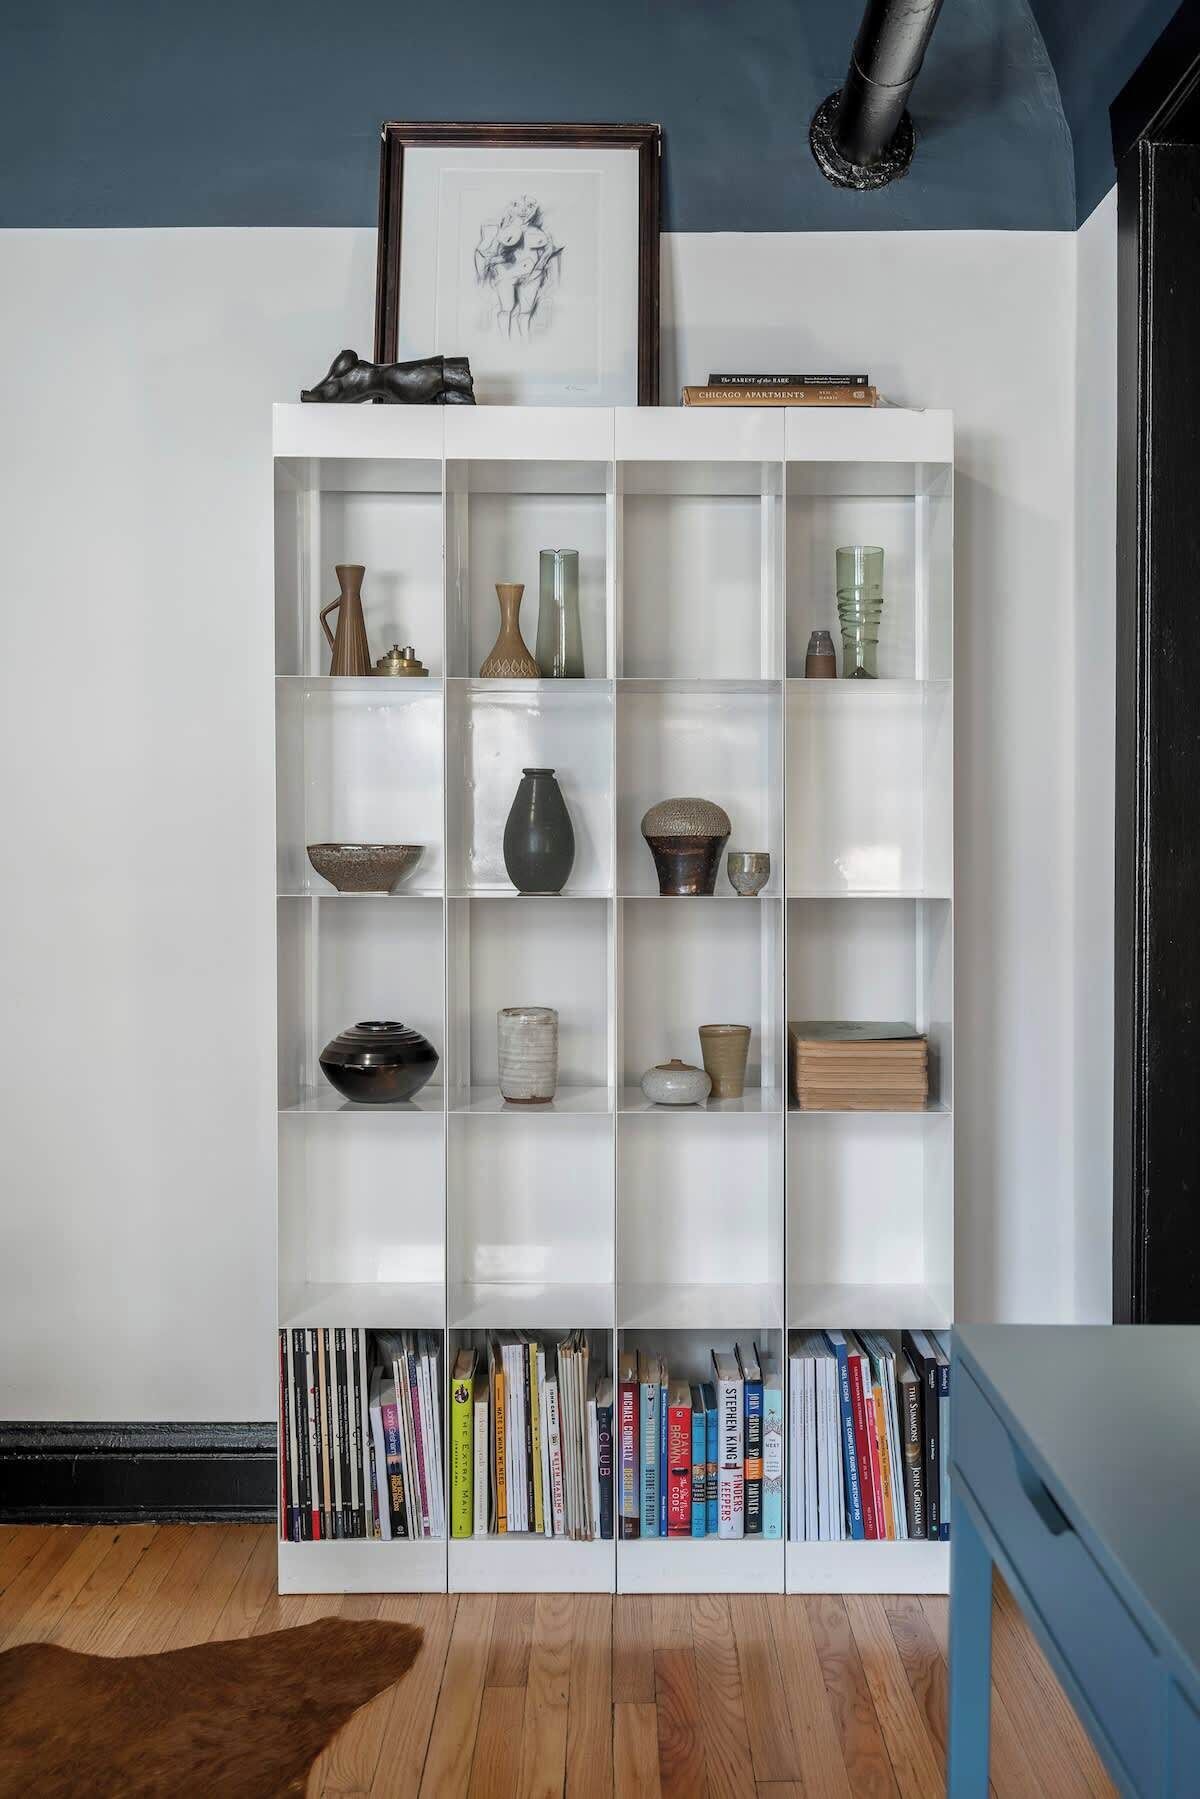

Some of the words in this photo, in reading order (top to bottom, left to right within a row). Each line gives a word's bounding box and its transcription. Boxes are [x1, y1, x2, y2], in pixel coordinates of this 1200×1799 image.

[699, 391, 741, 399] CHICAGO
[745, 391, 805, 399] APARTMENTS
[623, 1392, 633, 1423] MICHAEL
[748, 1393, 760, 1410] JOHN
[908, 1386, 917, 1402] THE
[387, 1408, 396, 1427] John
[726, 1388, 737, 1432] STEPHEN
[909, 1403, 919, 1442] SUMMONS
[462, 1413, 470, 1438] THE
[749, 1414, 760, 1442] GRISHAM
[388, 1427, 398, 1455] Grisham
[599, 1432, 611, 1476] CLUB
[623, 1426, 633, 1461] CONNELLY
[670, 1424, 680, 1464] BROWN
[681, 1433, 689, 1455] DAN
[726, 1436, 737, 1460] KING
[846, 1428, 854, 1455] COMPLETE
[462, 1444, 470, 1482] EXTRA
[749, 1448, 760, 1479] SPARRING
[646, 1469, 655, 1490] BEFORE
[911, 1467, 921, 1488] JOHN
[646, 1492, 655, 1503] THE
[680, 1489, 688, 1500] Da
[721, 1482, 731, 1521] KEEPERS
[734, 1474, 743, 1512] FINDERS
[749, 1484, 760, 1515] PARTNERS
[913, 1489, 923, 1525] GRISHAM
[646, 1504, 655, 1526] POISON
